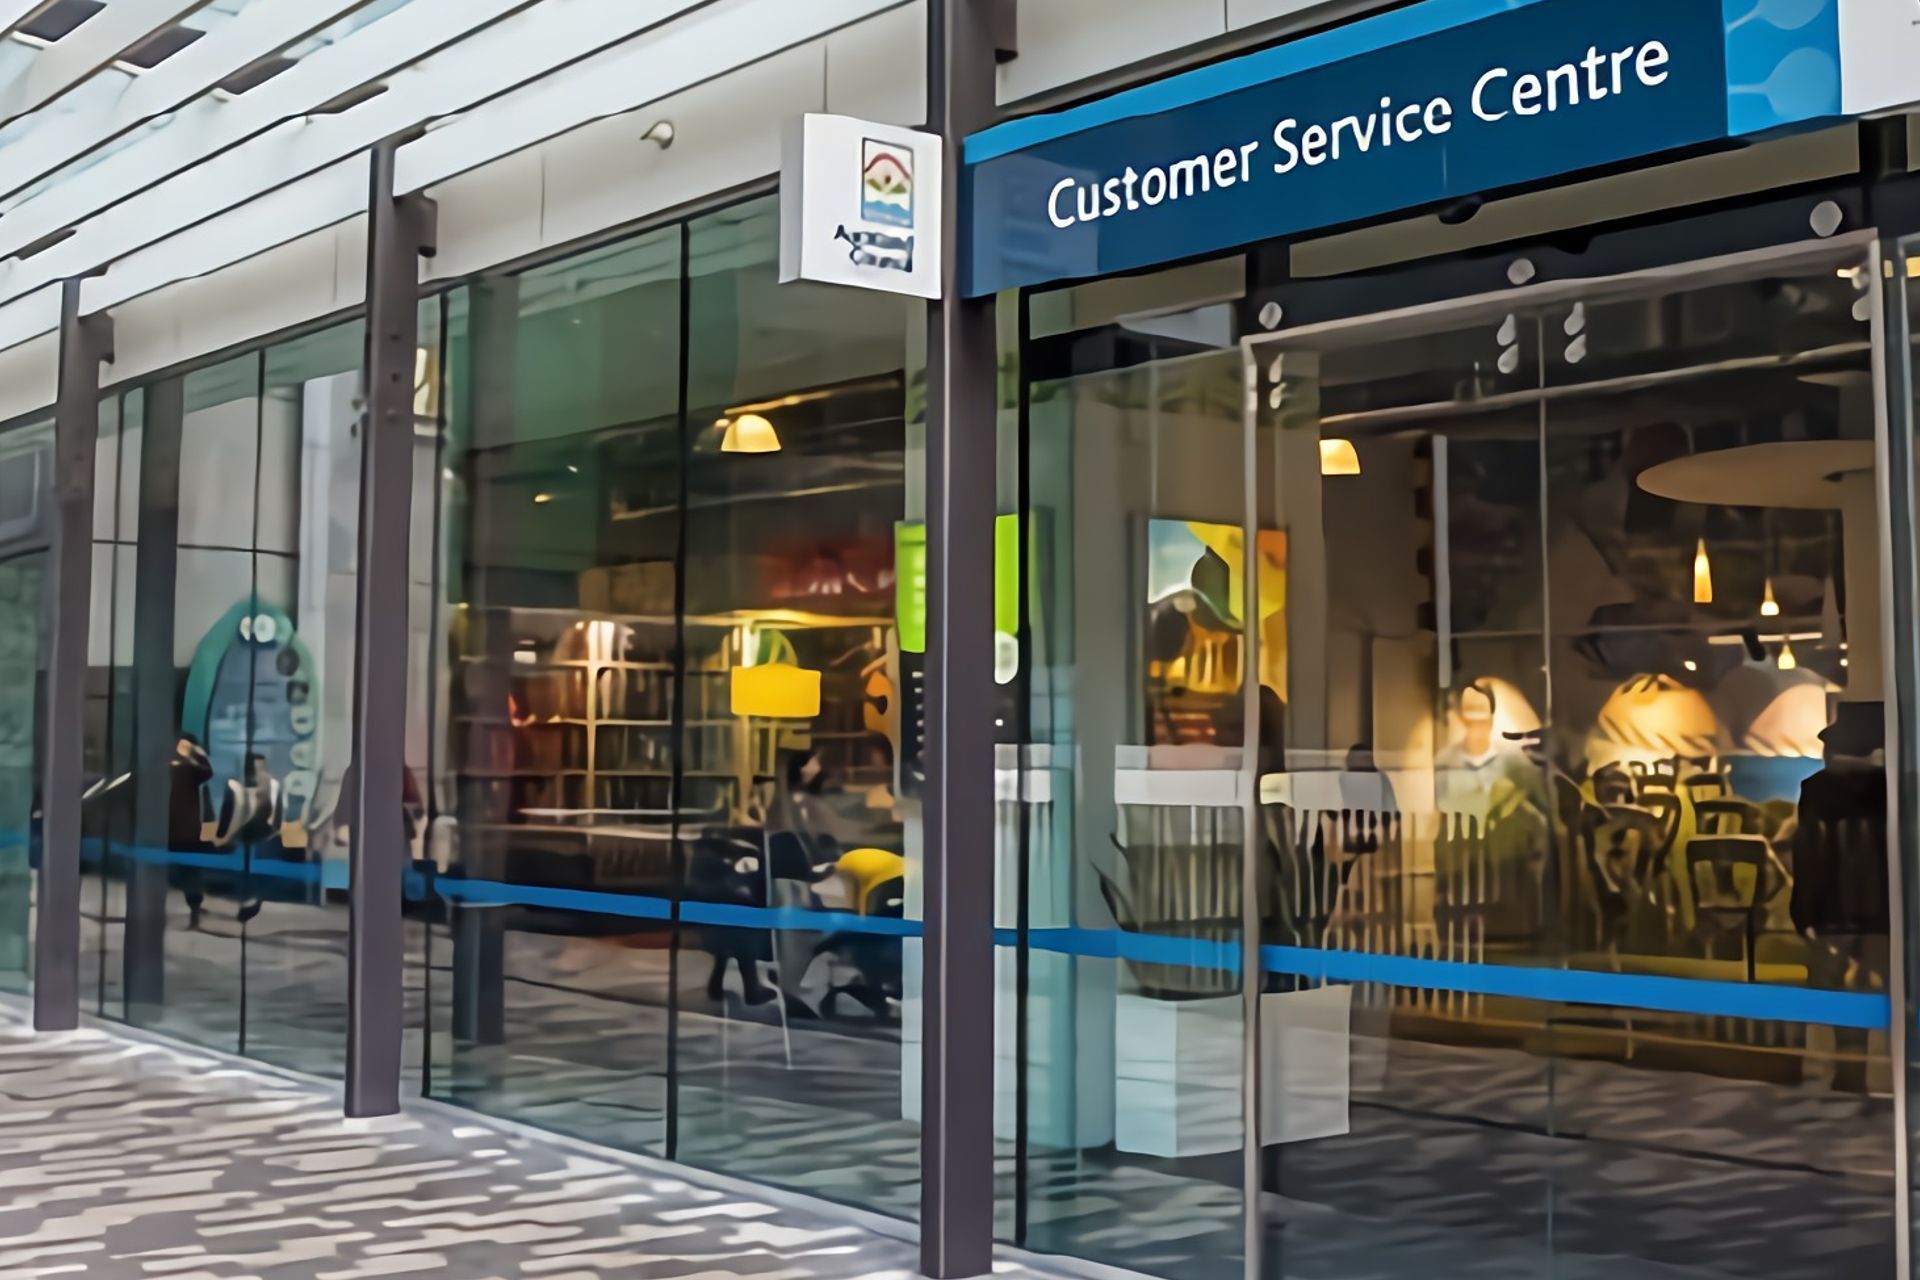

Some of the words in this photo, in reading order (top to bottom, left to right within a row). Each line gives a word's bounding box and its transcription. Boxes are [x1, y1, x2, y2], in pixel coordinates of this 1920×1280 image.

[1047, 140, 1259, 230] Customer
[1272, 96, 1453, 174] Service
[1471, 39, 1669, 122] Centre
